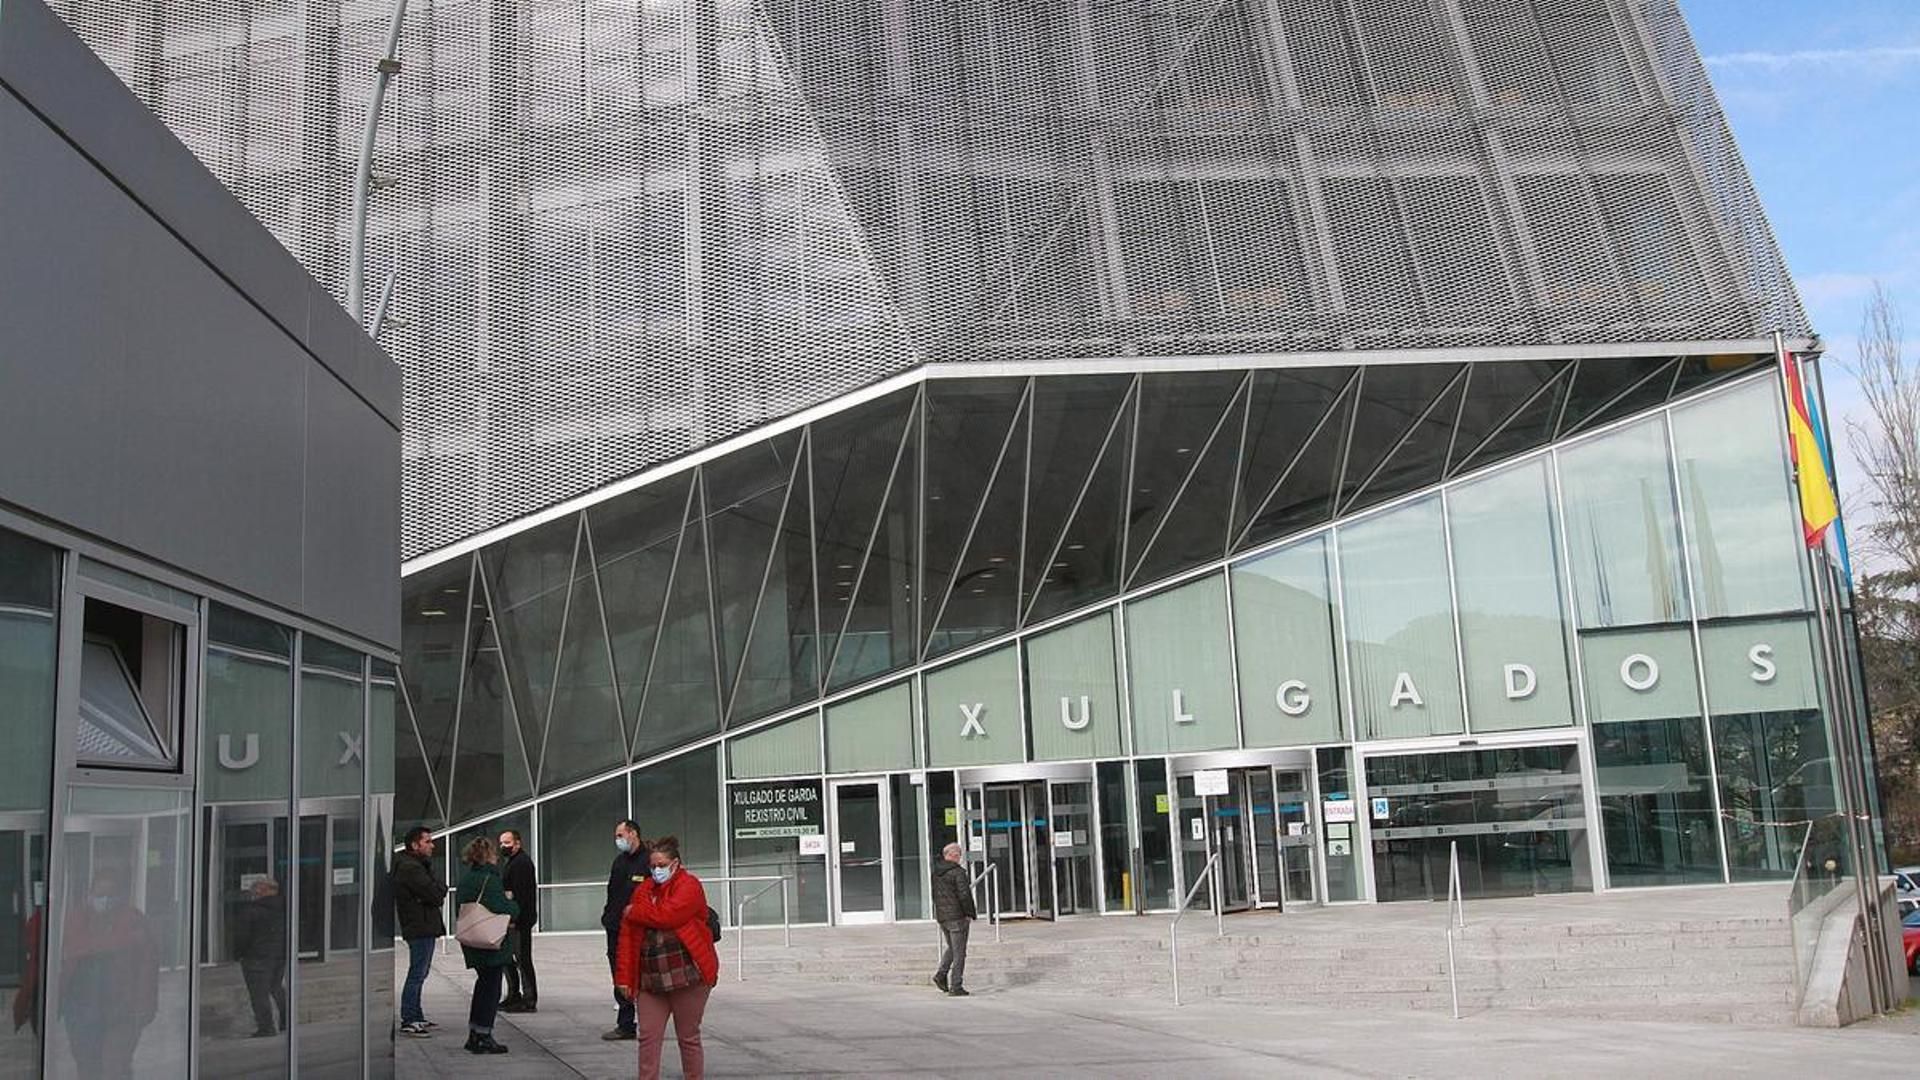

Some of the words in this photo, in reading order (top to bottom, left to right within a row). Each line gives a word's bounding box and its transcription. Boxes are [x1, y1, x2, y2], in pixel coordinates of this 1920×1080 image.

[960, 644, 1777, 737] XULGADOS
[733, 789, 773, 805] XULGADO
[775, 789, 787, 803] DE
[788, 787, 818, 802] GARDA
[744, 807, 786, 823] REXISTRO
[787, 806, 808, 821] CIVIL
